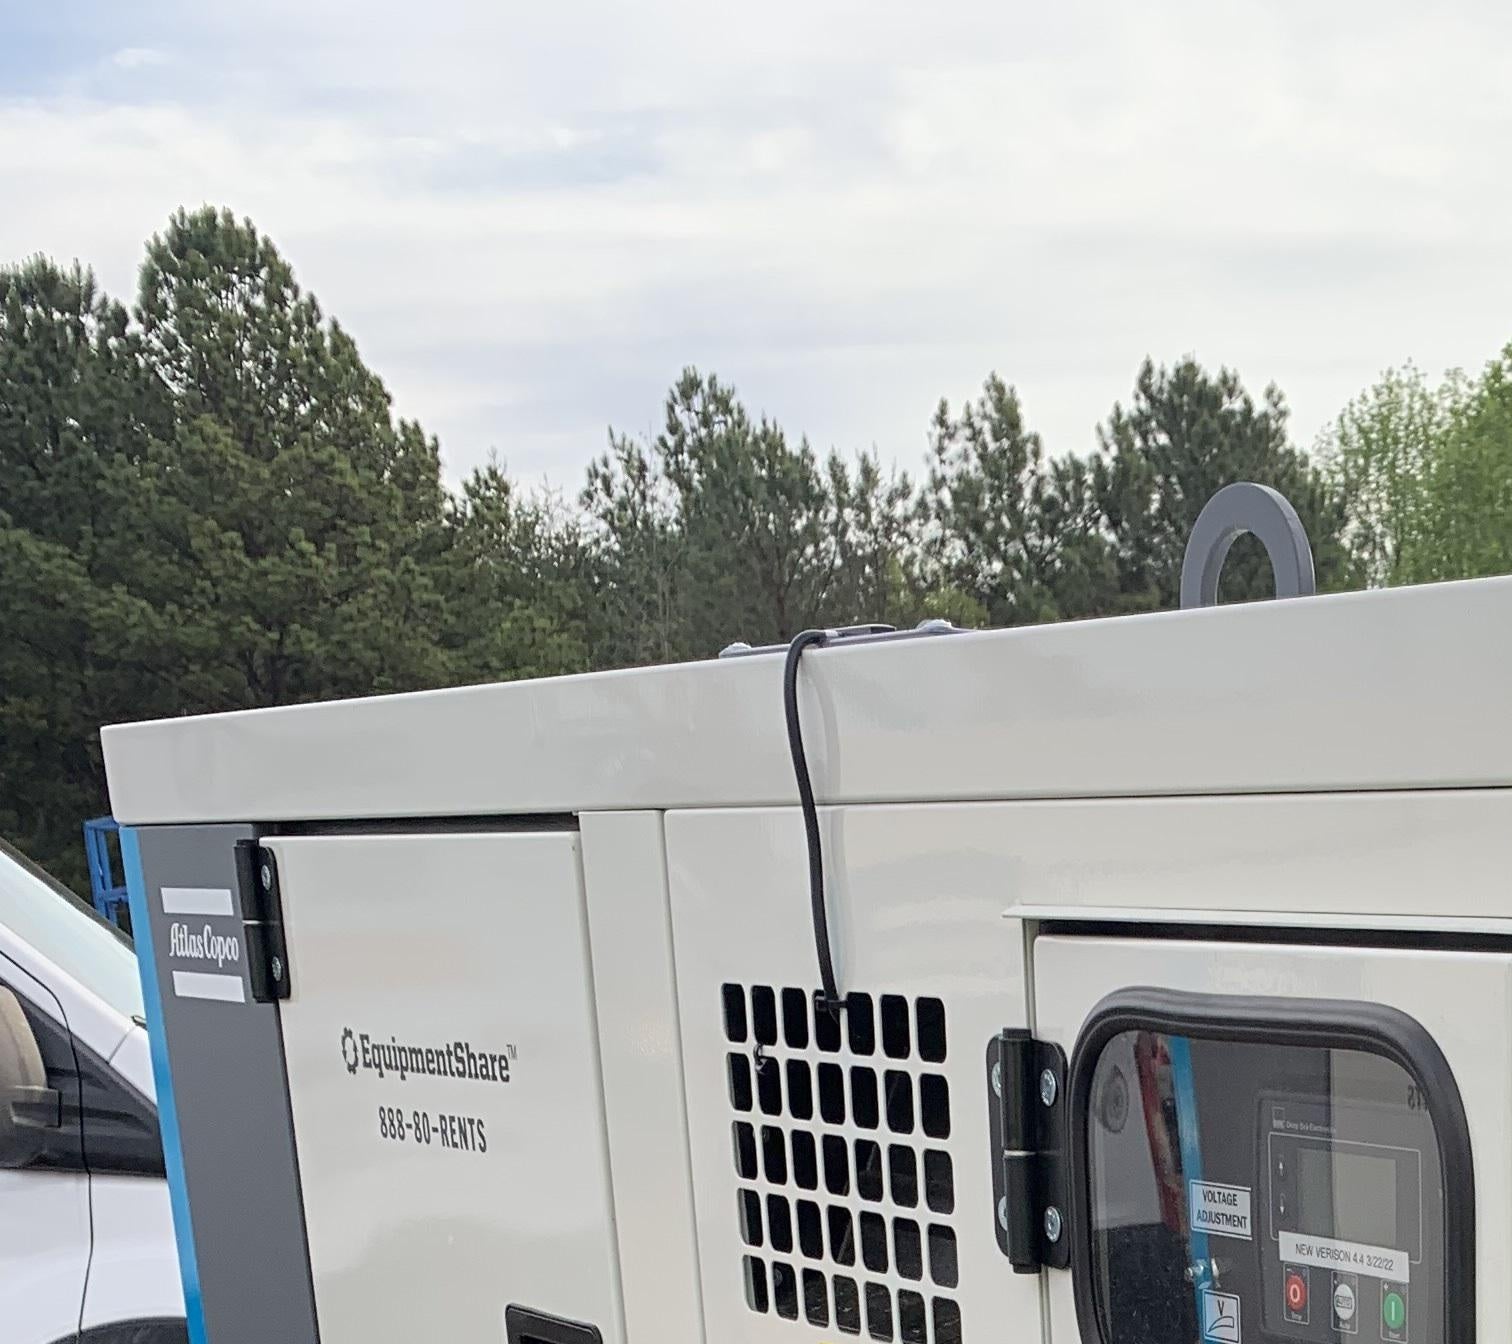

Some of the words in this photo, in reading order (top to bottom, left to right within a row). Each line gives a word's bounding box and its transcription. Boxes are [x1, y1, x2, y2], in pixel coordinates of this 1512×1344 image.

[359, 1033, 510, 1084] EquipmentShare
[378, 1106, 488, 1153] 888-80-RENTS
[1202, 1188, 1238, 1207] VOLTAGE
[1197, 1209, 1248, 1229] ADJUSTMENT
[1296, 1243, 1314, 1257] NEW
[1315, 1246, 1351, 1263] VERISON
[1352, 1252, 1365, 1265] 4.4
[1366, 1254, 1395, 1271] 3/22/22
[1217, 1300, 1225, 1316] V
